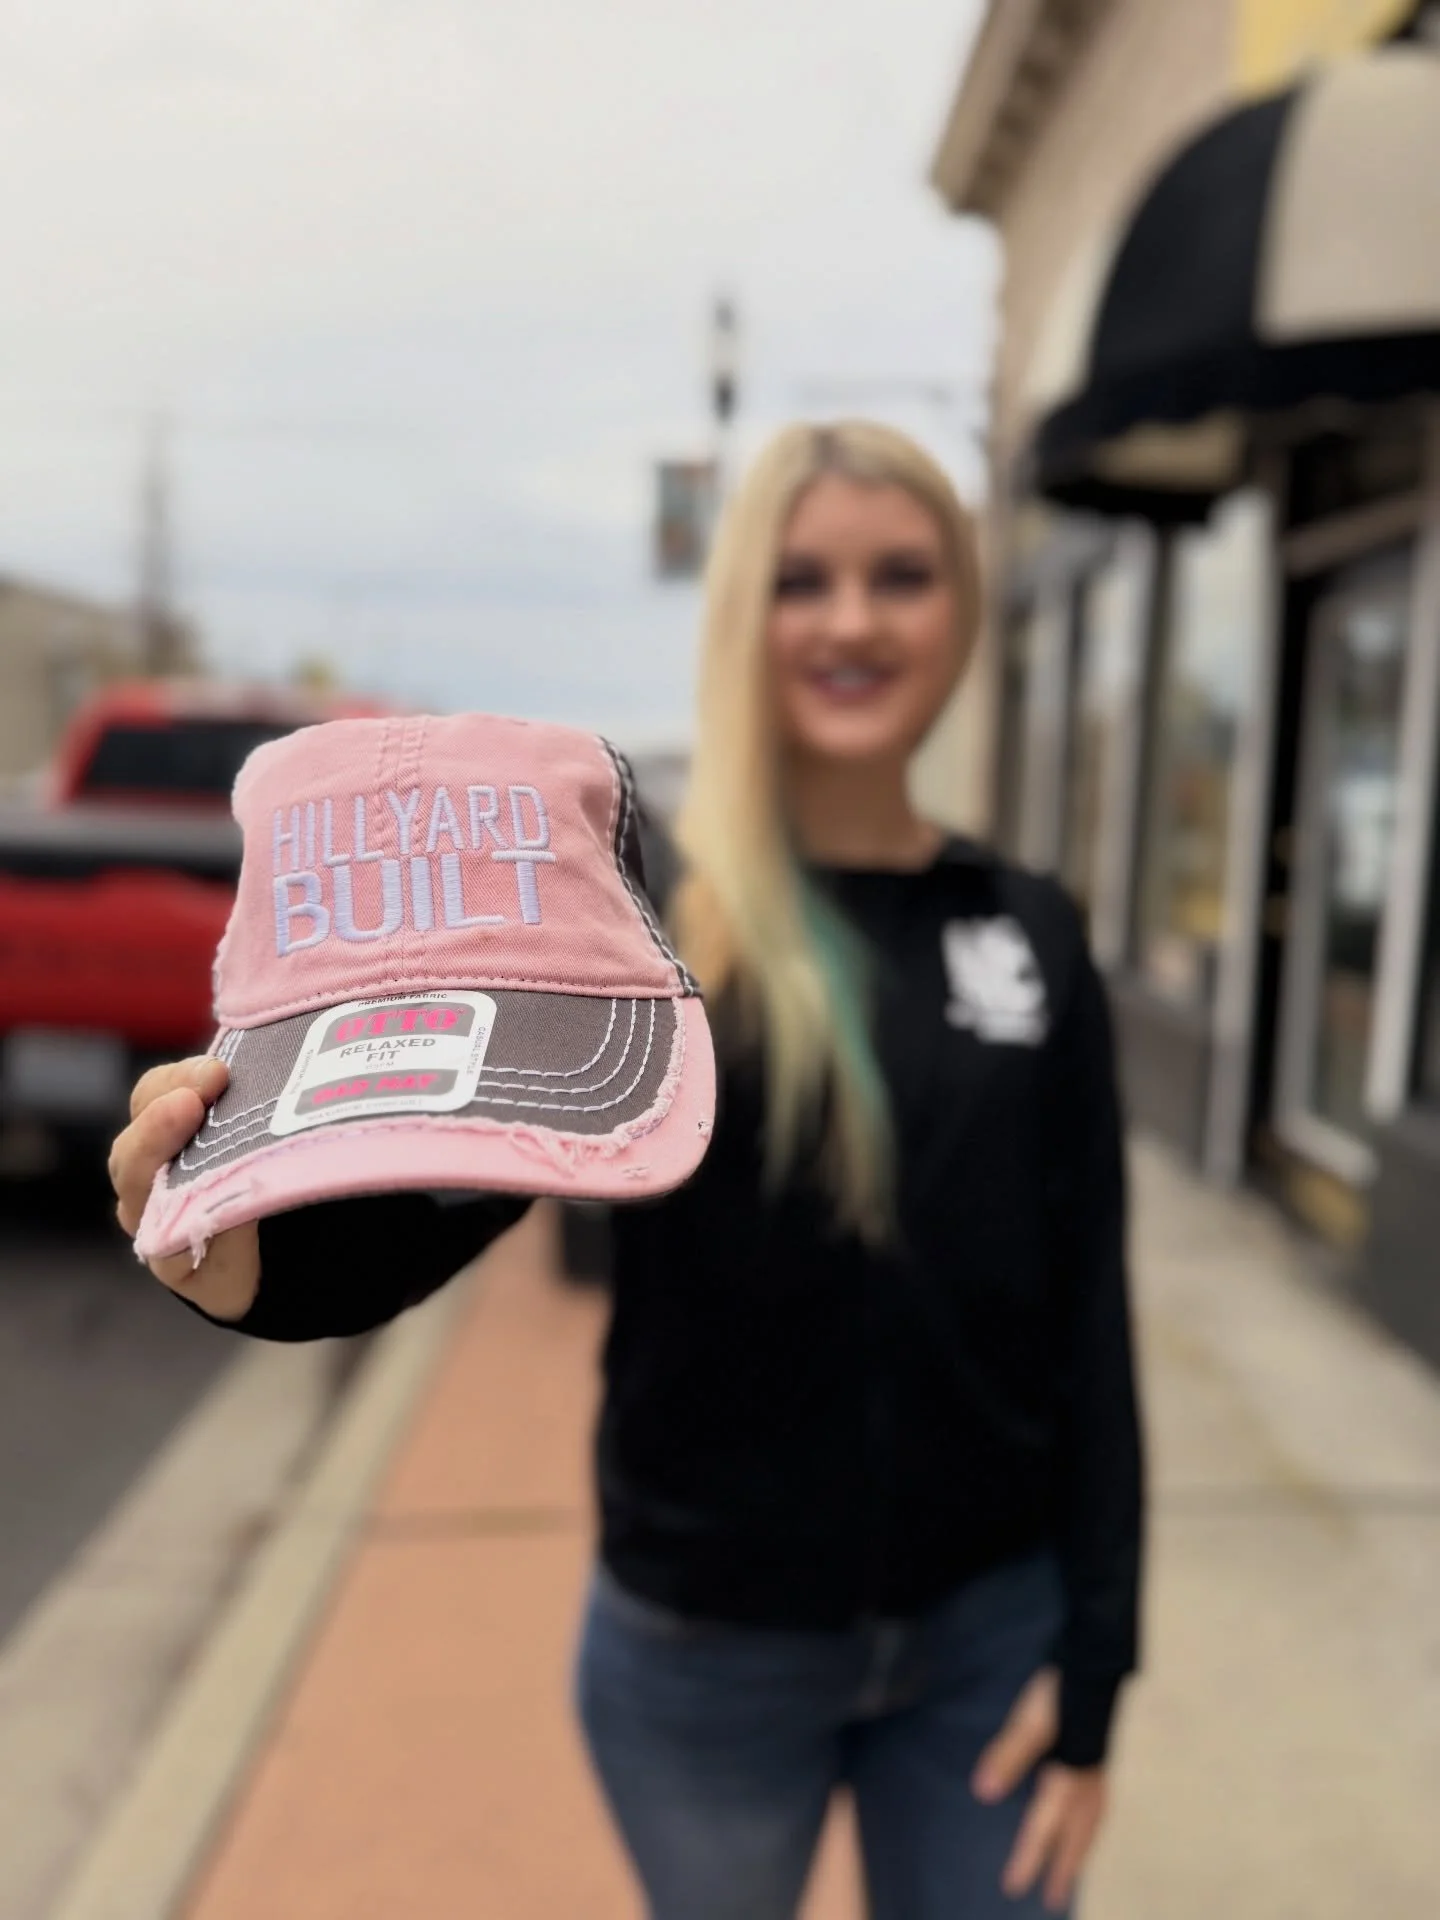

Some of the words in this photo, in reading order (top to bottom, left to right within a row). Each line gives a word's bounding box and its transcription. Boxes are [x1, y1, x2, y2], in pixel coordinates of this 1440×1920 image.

[273, 784, 551, 875] HILLYARD
[273, 850, 556, 957] BUILT
[358, 994, 406, 1007] PREMIUM
[335, 1007, 459, 1042] OTTO
[340, 1038, 437, 1059] RELAXED
[366, 1050, 401, 1063] FIT
